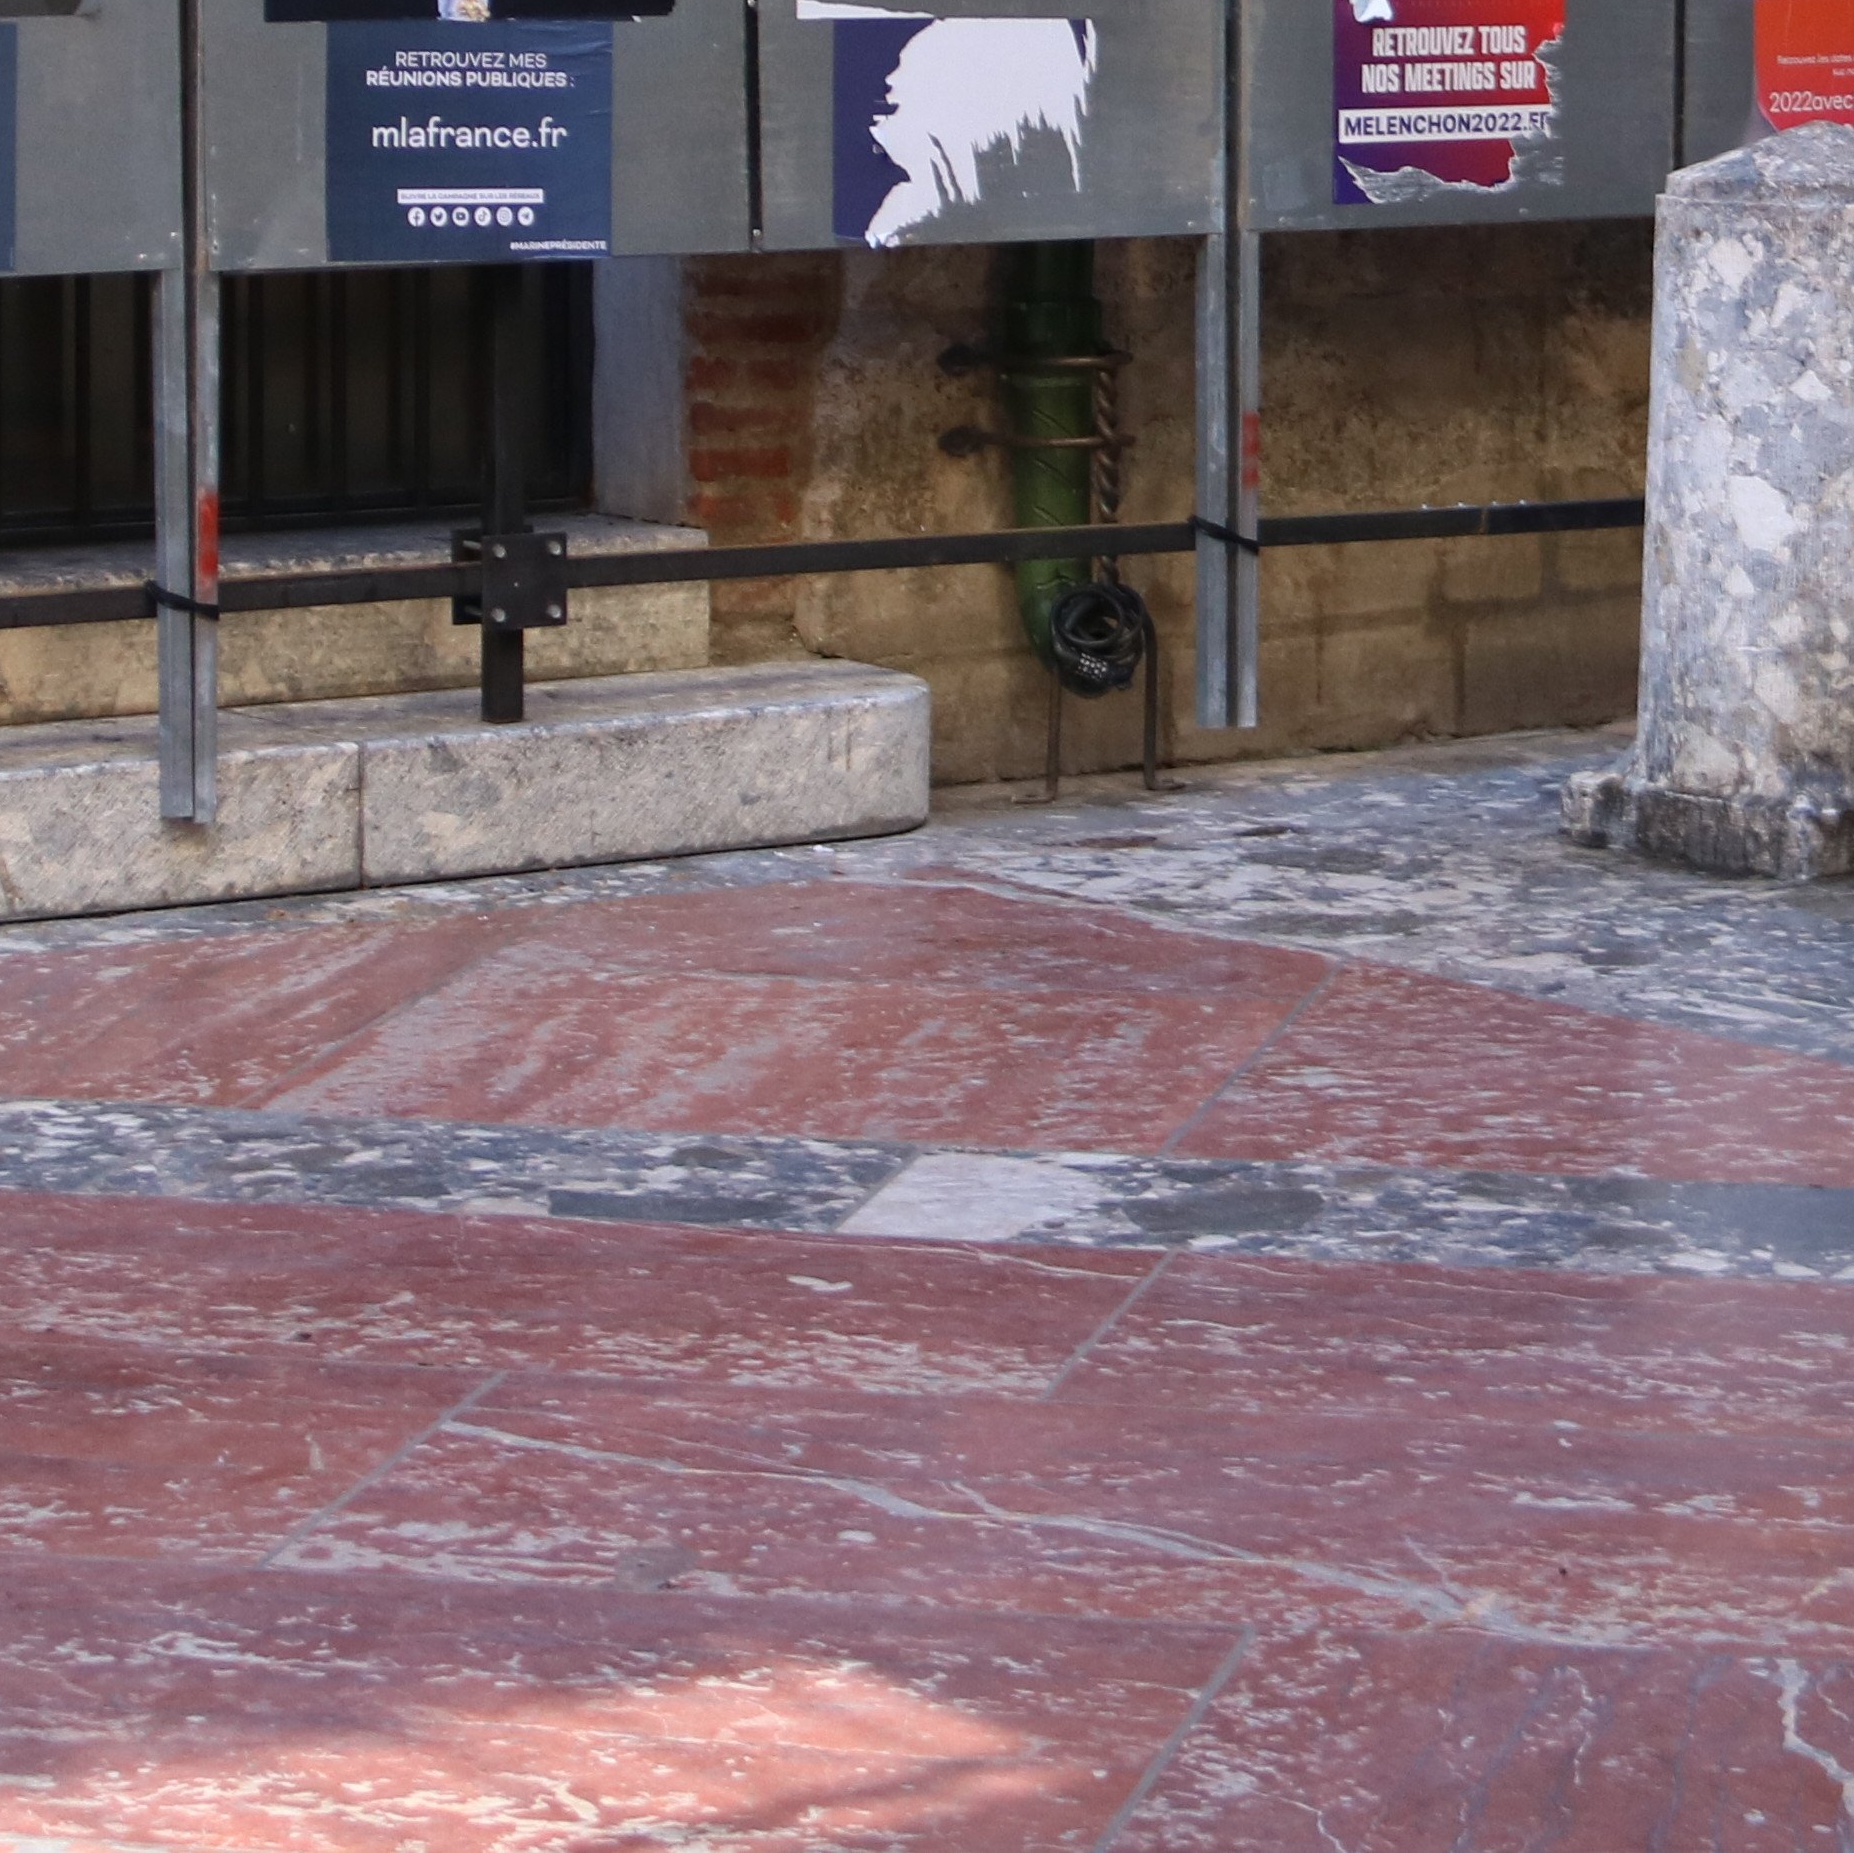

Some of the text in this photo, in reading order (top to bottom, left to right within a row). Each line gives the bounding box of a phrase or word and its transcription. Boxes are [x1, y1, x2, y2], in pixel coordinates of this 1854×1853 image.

[1372, 25, 1526, 57] RETROUVEZ TOUS
[395, 51, 547, 68] RETROUVEZ MES
[366, 65, 567, 89] RÉUNIONS PUBLIQUES
[1361, 60, 1536, 93] NOS MEETINGS SUR
[372, 116, 568, 148] mlafrance.fr
